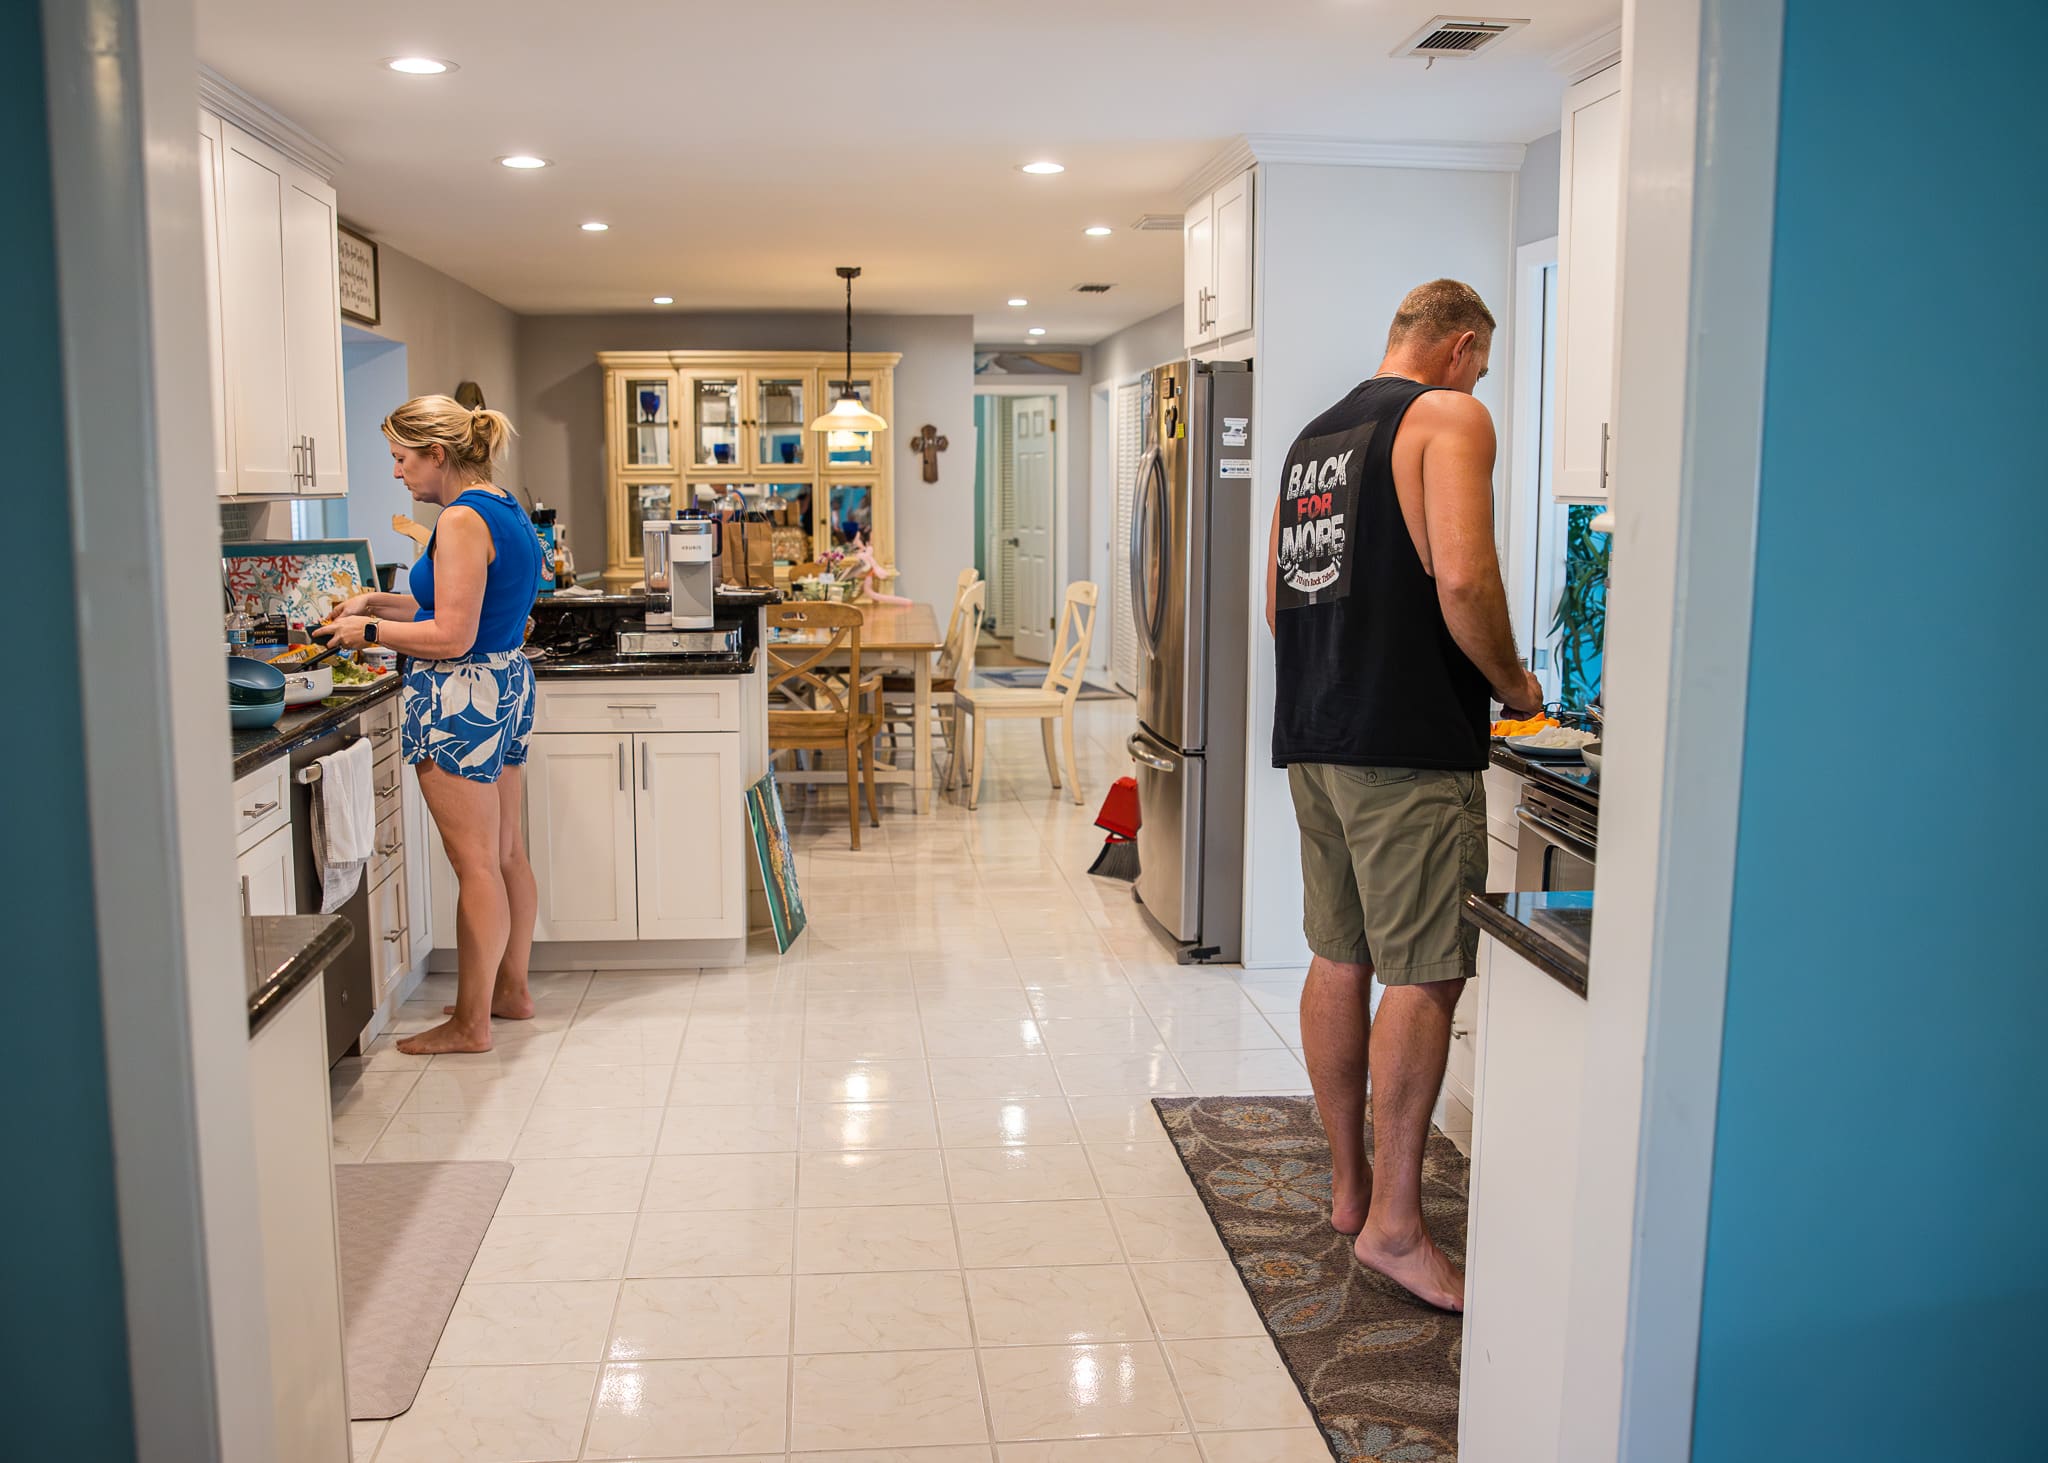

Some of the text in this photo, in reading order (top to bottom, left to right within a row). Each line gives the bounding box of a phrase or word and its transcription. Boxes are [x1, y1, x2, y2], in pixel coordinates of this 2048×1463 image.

[1287, 449, 1353, 500] BACK
[1297, 492, 1332, 522] FOR
[1281, 514, 1345, 561] MORE
